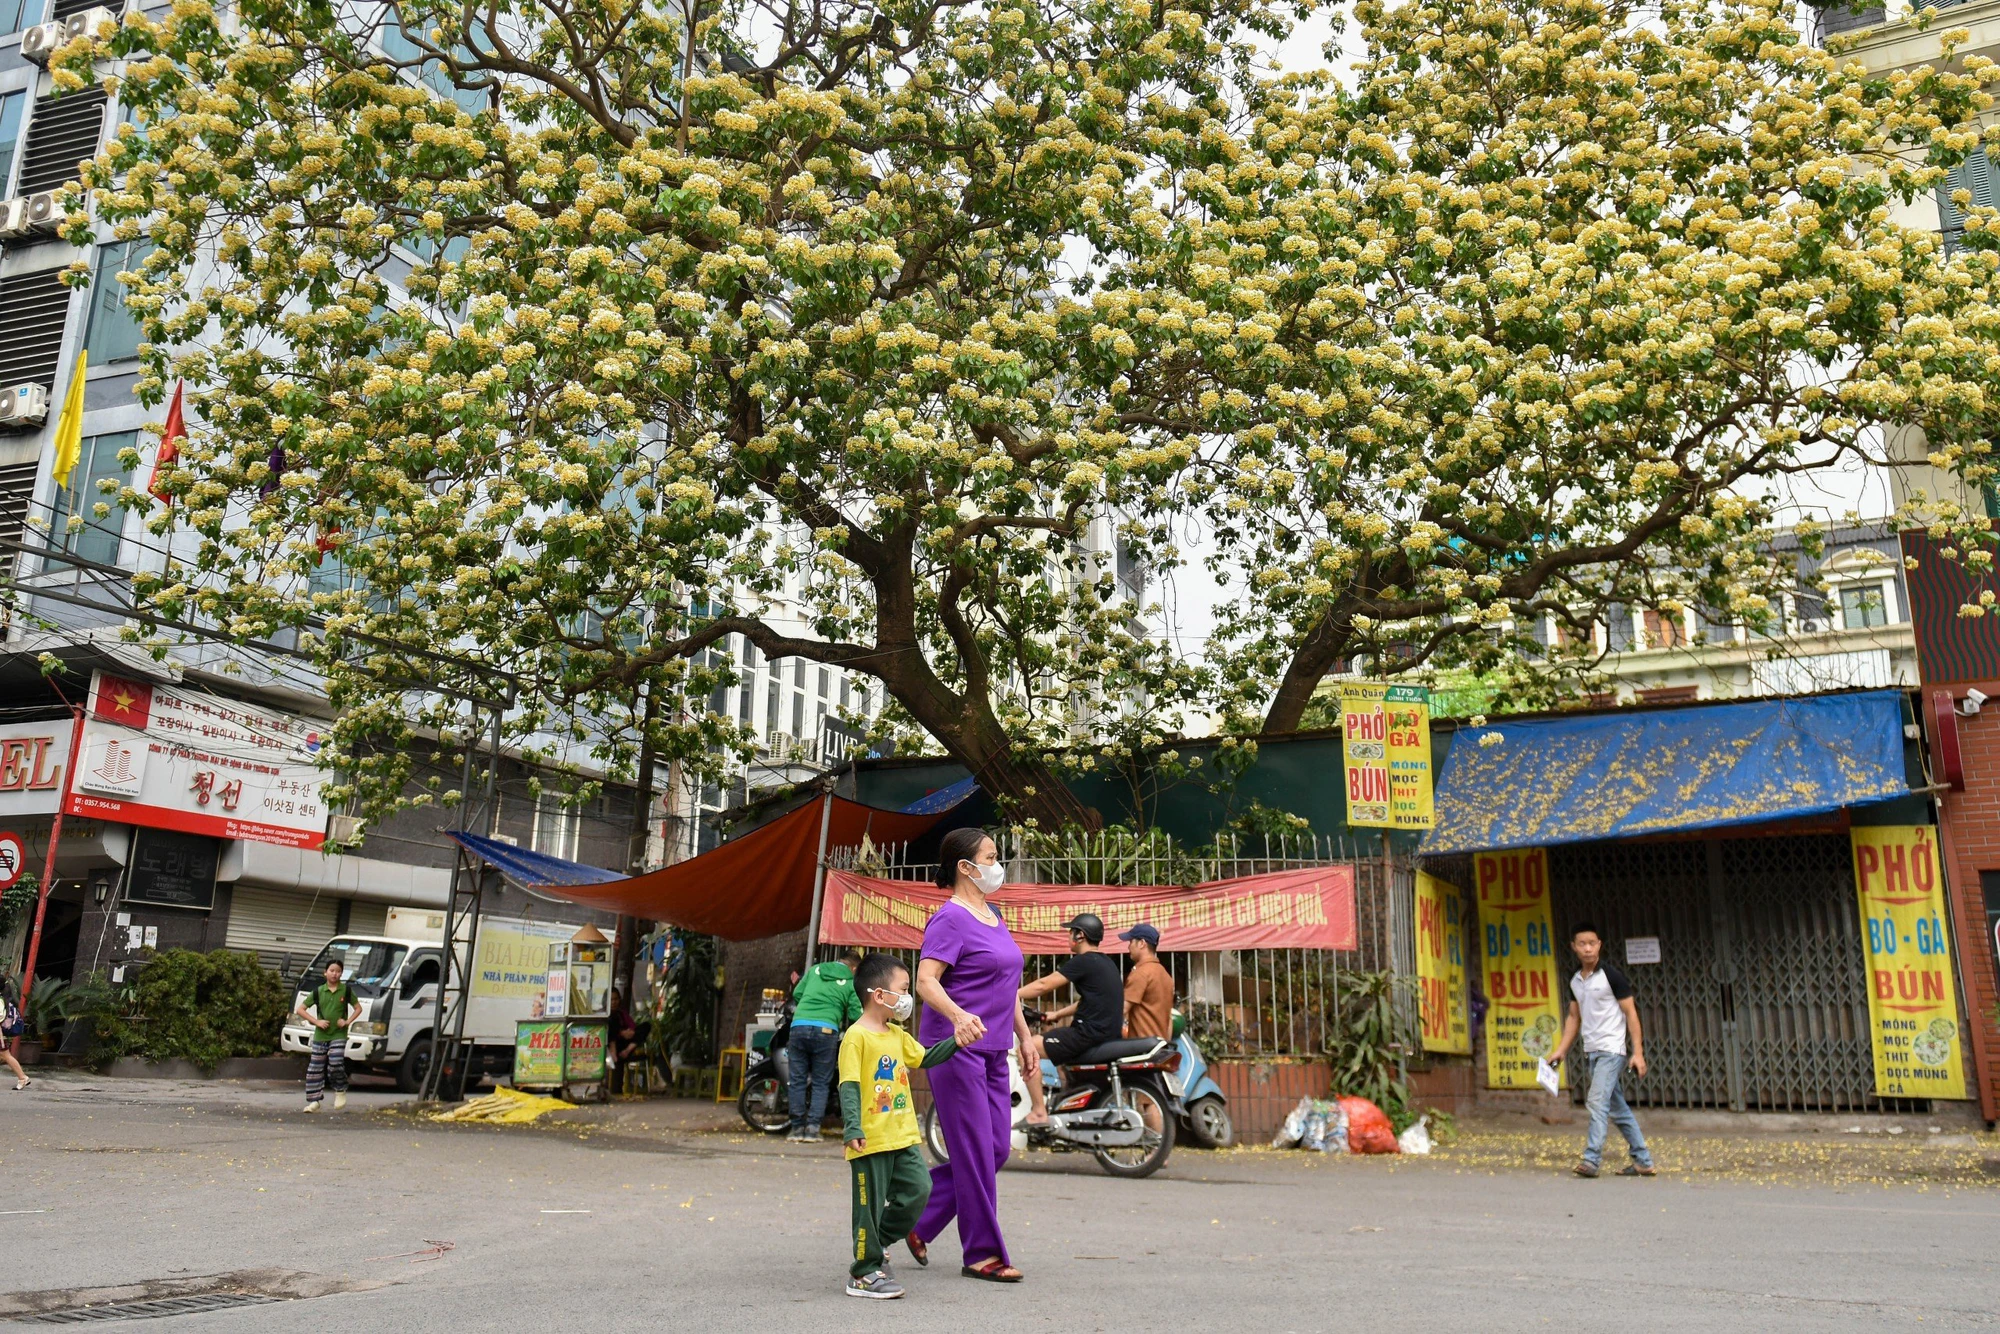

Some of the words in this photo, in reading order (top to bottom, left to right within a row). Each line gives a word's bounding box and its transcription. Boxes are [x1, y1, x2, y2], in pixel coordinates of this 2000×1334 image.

[1395, 687, 1415, 697] 179
[1346, 705, 1385, 741] PHỞ
[1390, 729, 1420, 748] GÀ
[278, 779, 311, 798] 부동산
[1348, 761, 1388, 803] BÚN
[299, 804, 317, 818] 센터
[1857, 827, 1935, 893] PHỞ
[1213, 891, 1234, 927] VÀ
[1236, 890, 1257, 927] CÓ
[1259, 888, 1293, 932] HIỆU
[1868, 909, 1897, 955] BÒ
[1916, 910, 1946, 955] GÀ
[1490, 964, 1550, 999] BÚN
[1874, 963, 1945, 1001] BÚN
[528, 1029, 562, 1049] MÍA
[570, 1034, 602, 1049] MÍA
[1884, 1036, 1909, 1048] MỌC
